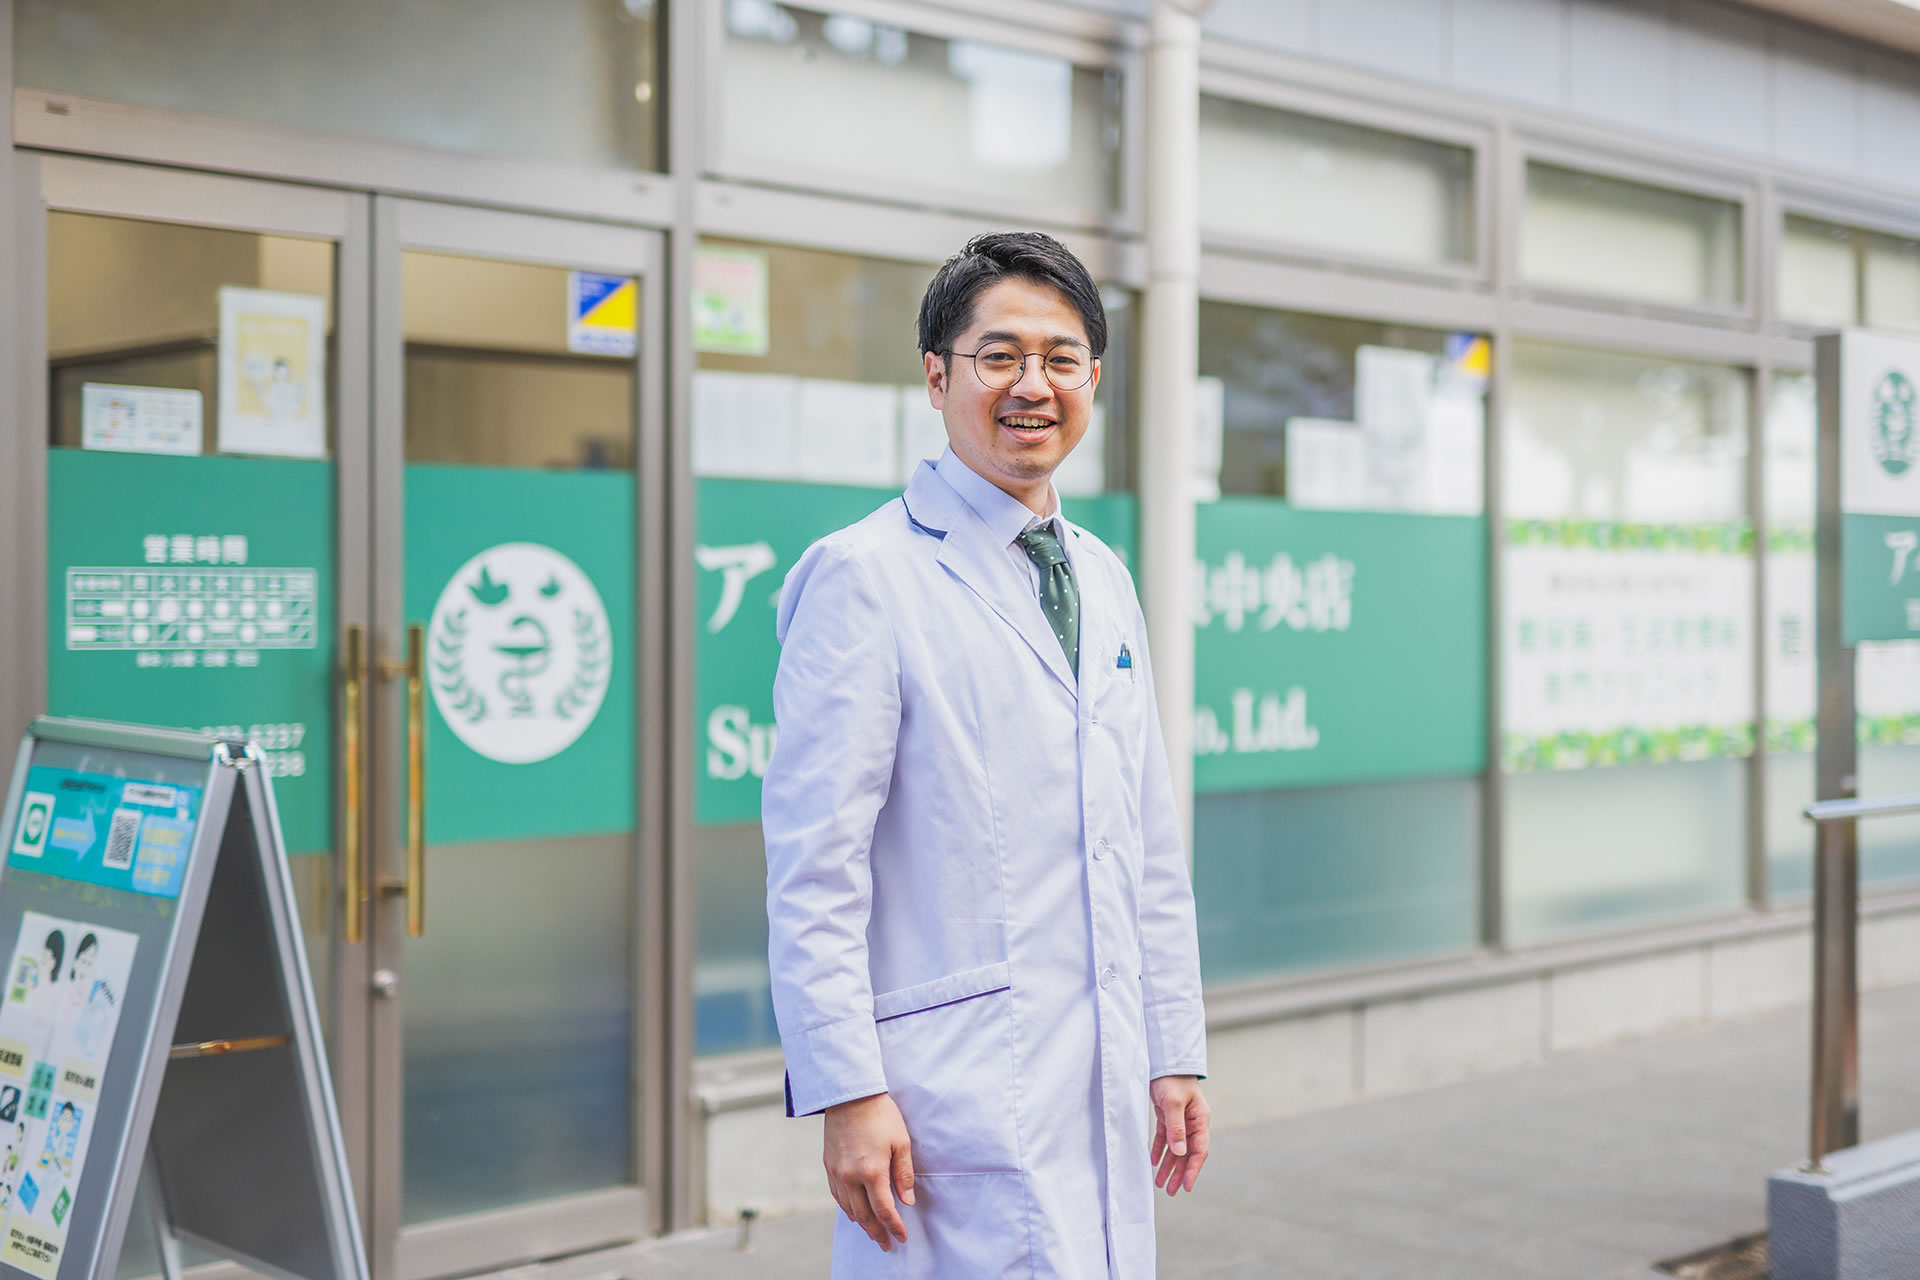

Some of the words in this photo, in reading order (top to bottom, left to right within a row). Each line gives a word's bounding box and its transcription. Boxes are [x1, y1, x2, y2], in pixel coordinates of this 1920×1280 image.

[143, 534, 248, 565] 営業時間
[1885, 531, 1920, 586] ア
[695, 541, 782, 634] ア
[1195, 705, 1229, 755] o.
[1233, 686, 1319, 752] Ltd.
